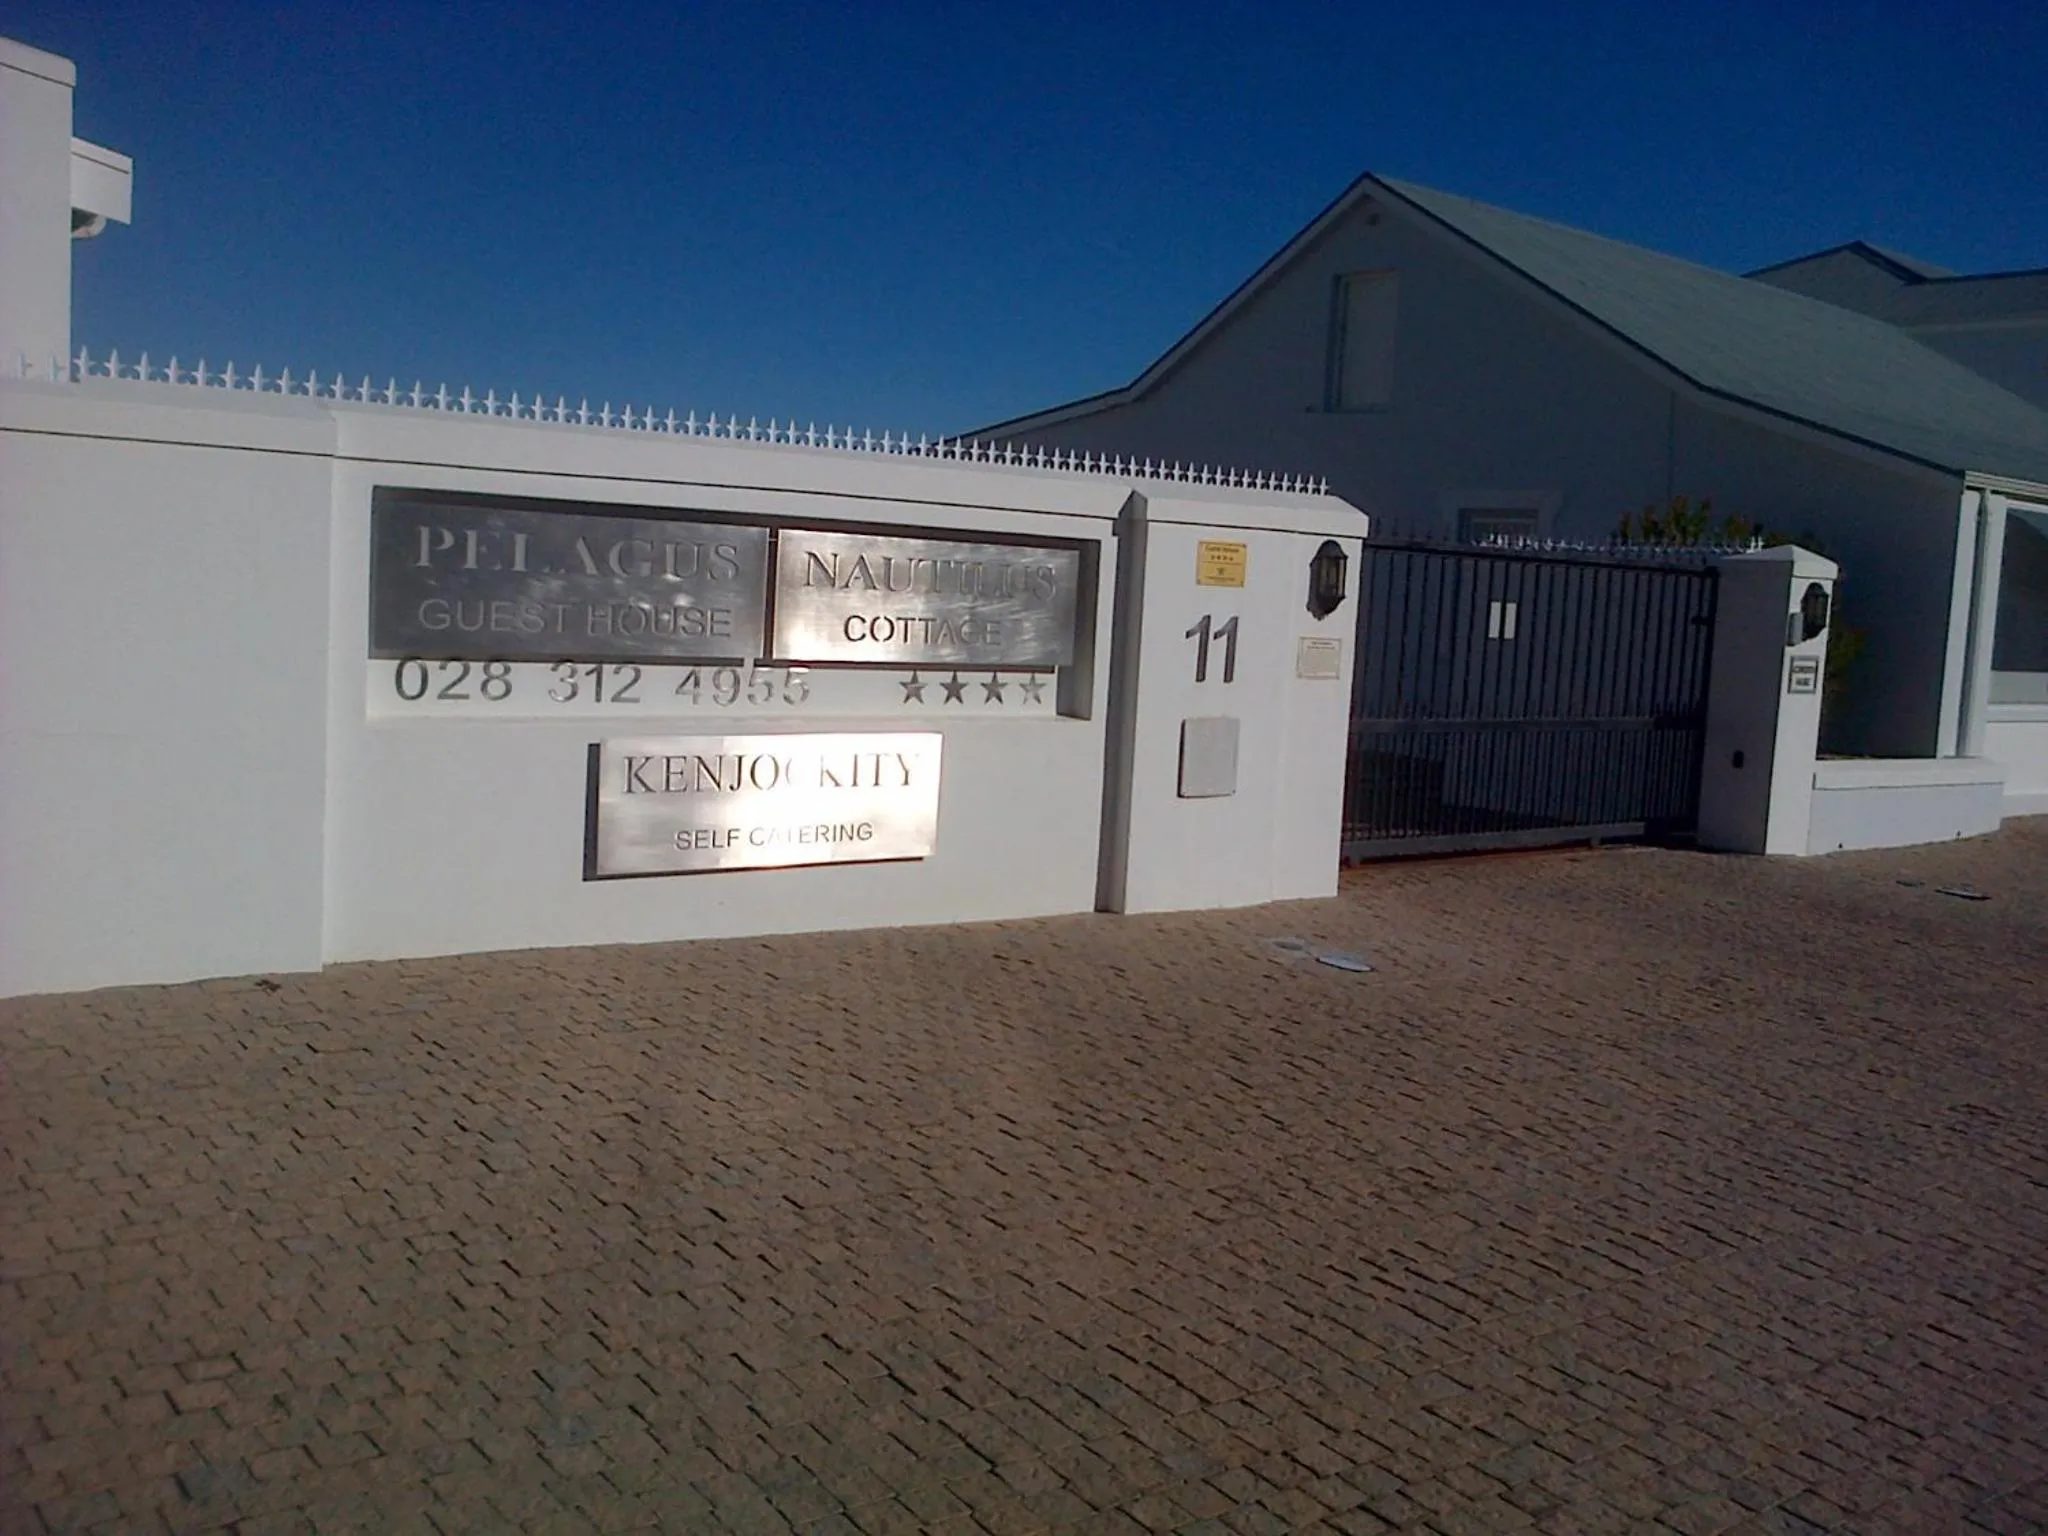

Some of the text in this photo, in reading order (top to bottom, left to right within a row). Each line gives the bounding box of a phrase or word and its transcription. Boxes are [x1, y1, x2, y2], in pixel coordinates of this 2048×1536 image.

[414, 525, 741, 581] PELAGUS
[803, 551, 1057, 601] NAUTILUS
[418, 598, 732, 638] GUEST HOUSE
[843, 614, 1001, 646] COTTAGE
[1185, 614, 1239, 684] 11
[395, 656, 811, 707] 028 312 4955
[675, 828, 741, 850] SELF
